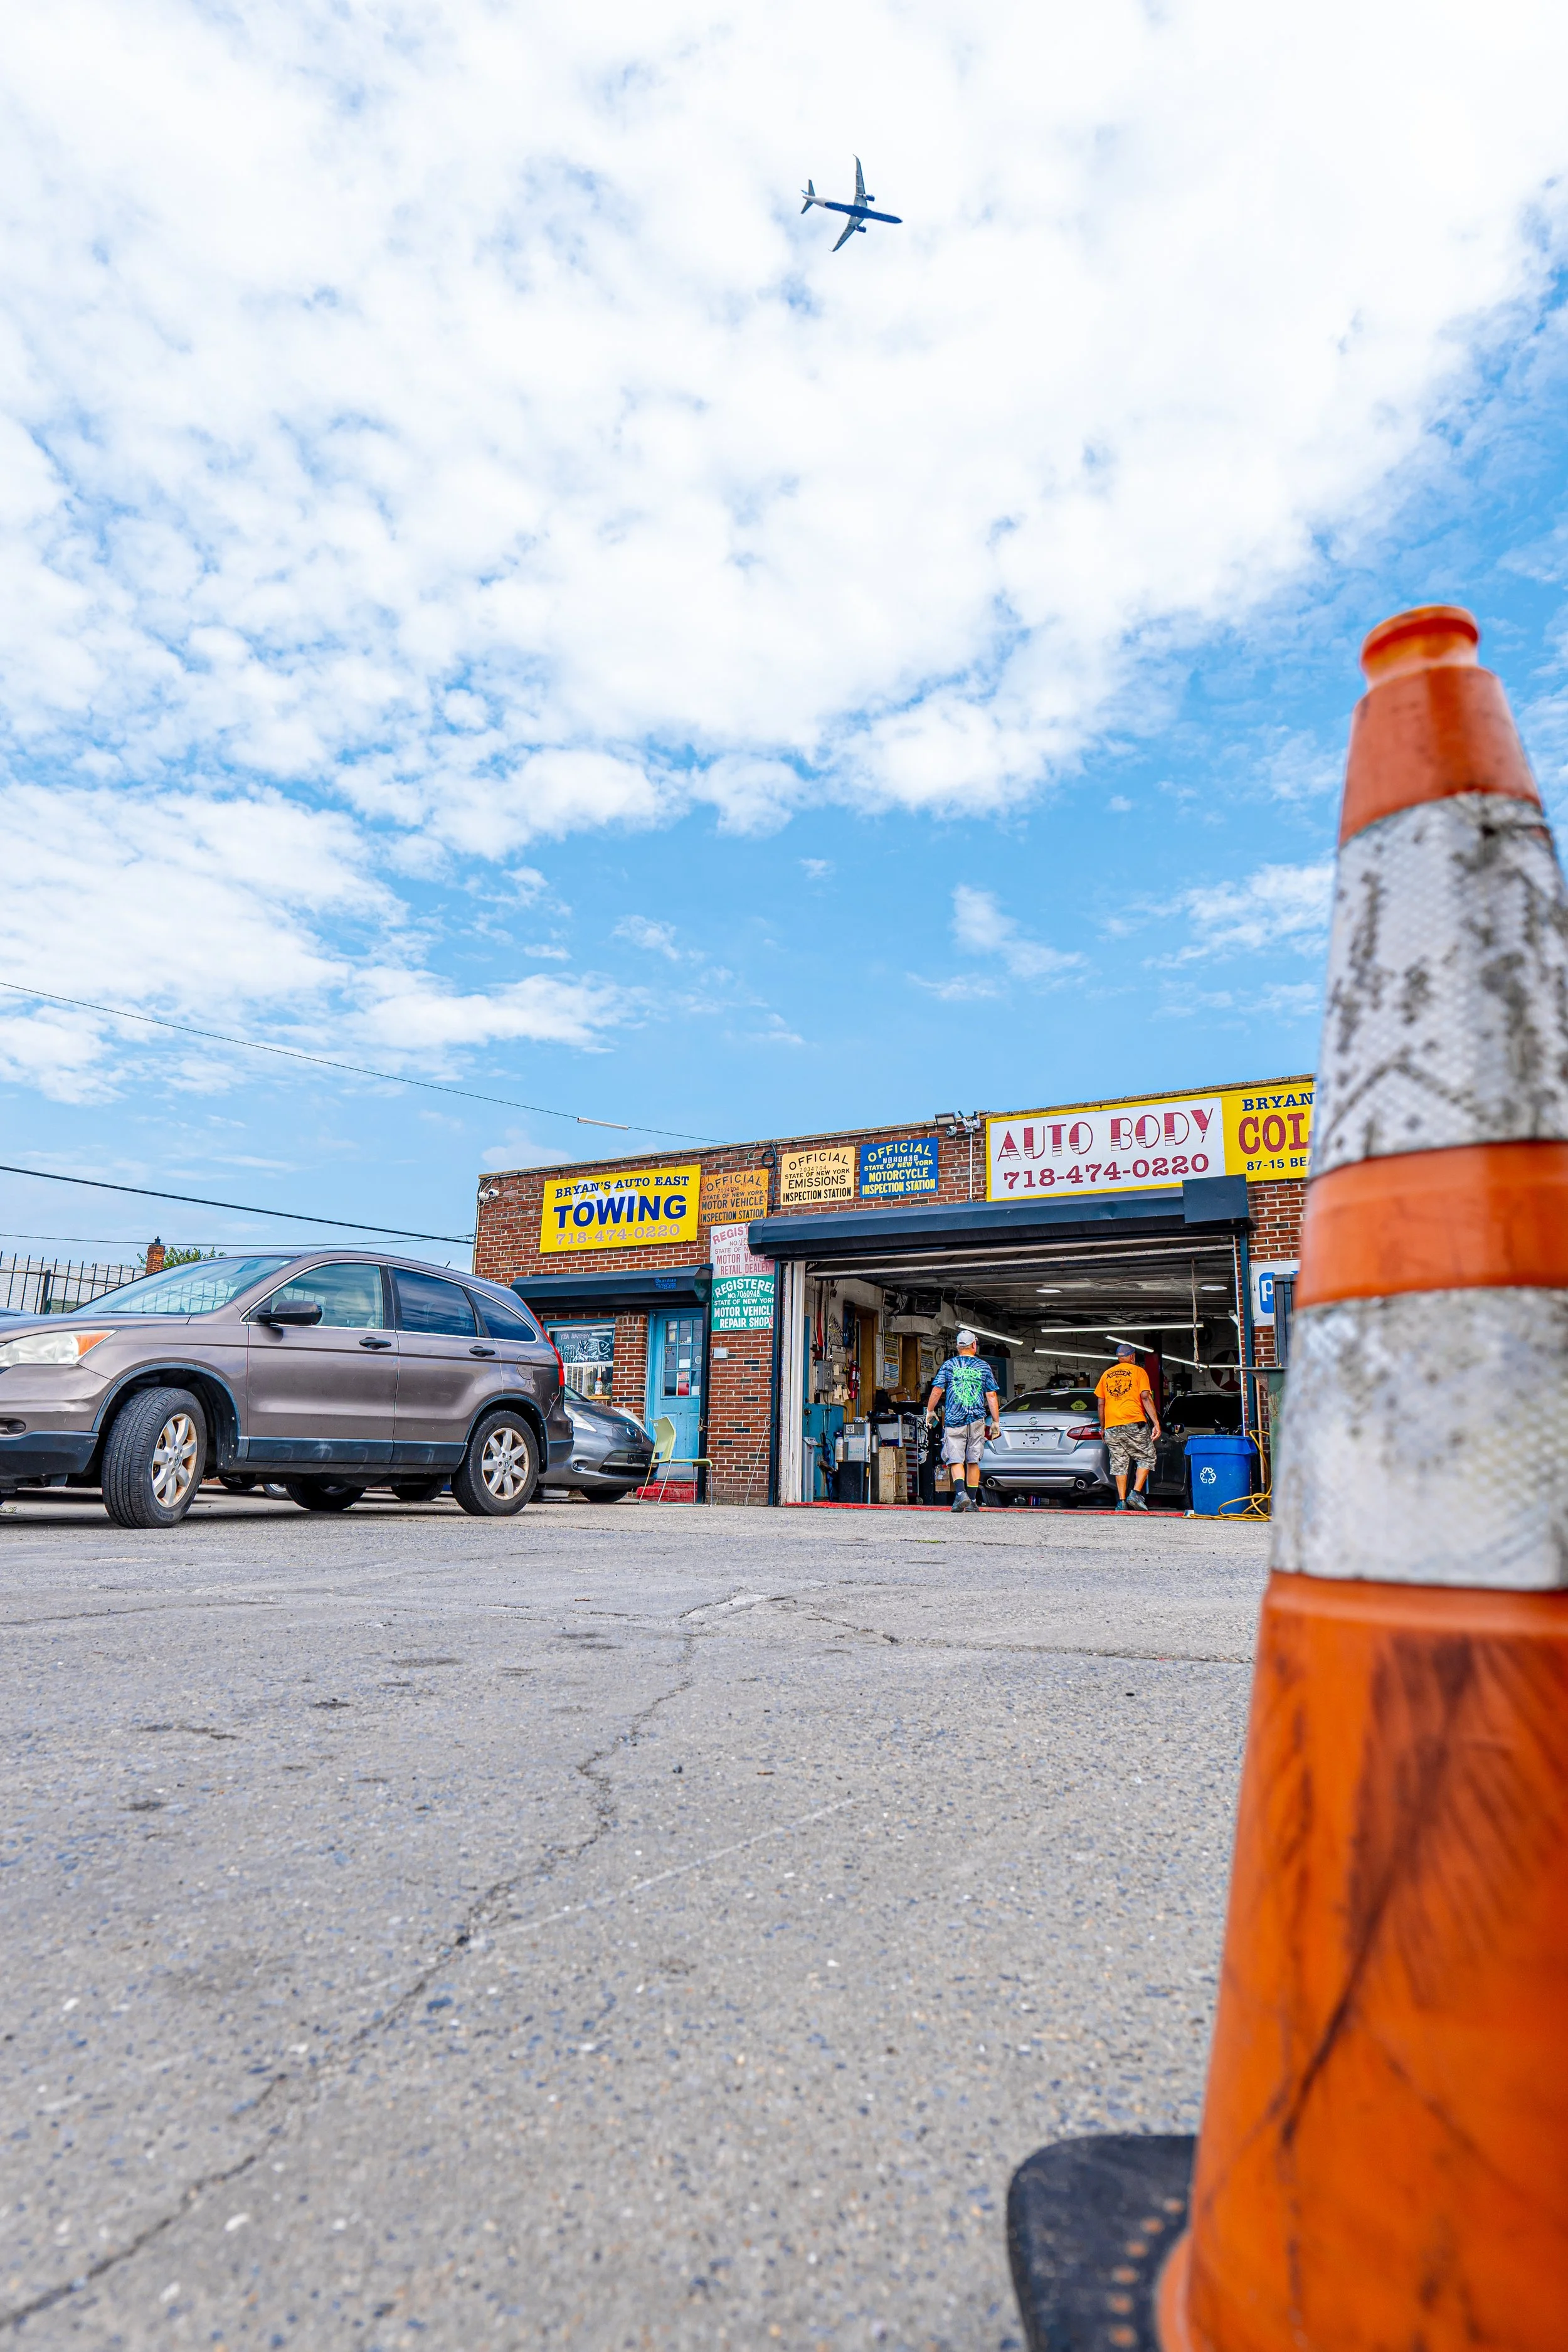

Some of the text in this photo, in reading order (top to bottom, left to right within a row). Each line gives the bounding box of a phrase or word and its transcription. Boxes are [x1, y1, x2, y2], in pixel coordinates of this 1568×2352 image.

[1242, 1093, 1315, 1111] BRYAN
[997, 1108, 1214, 1162] AUTO BODY
[1239, 1113, 1313, 1155] COL
[867, 1143, 931, 1162] OFFICIAL
[883, 1155, 918, 1163] 7034704
[789, 1152, 848, 1170] OFFICIAL
[1247, 1159, 1285, 1170] 87-15
[869, 1167, 929, 1182] MOTORCYCLE
[1004, 1153, 1209, 1189] 718-474-0220
[555, 1176, 689, 1199] BRYAN'S AUTO EAST
[706, 1174, 762, 1191] OFFICIAL
[788, 1175, 846, 1189] EMISSIONS
[862, 1179, 936, 1195] INSPECTION STATION
[783, 1187, 852, 1202] INSPECTION STATION
[702, 1195, 764, 1210] MOTOR VEHICLE
[553, 1195, 687, 1229] TOWING
[701, 1208, 764, 1222] INSPECTION STATION
[556, 1224, 680, 1245] 718-474-0220
[712, 1226, 748, 1245] REGIST
[716, 1254, 740, 1264] MOTOR
[721, 1262, 769, 1275] RETAIL DEALER
[737, 1290, 760, 1298] 7060948
[714, 1306, 740, 1317] MOTOR
[719, 1316, 768, 1328] REPAIR SHOP
